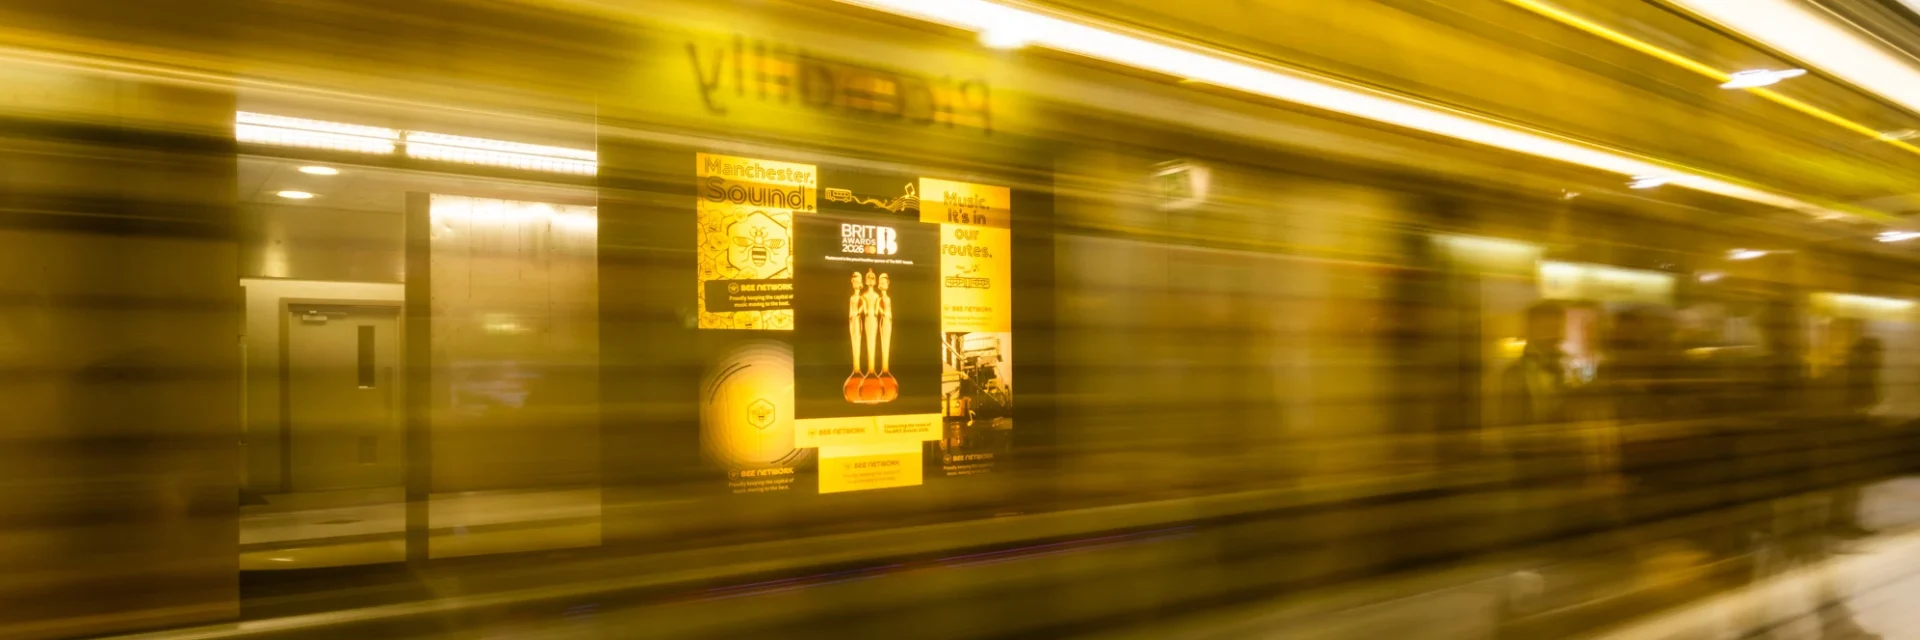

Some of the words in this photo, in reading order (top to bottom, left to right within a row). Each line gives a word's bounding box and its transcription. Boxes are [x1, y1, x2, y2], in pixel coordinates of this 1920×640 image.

[704, 157, 814, 185] Manchester.
[707, 175, 813, 211] Sound.
[943, 190, 990, 210] Music.
[947, 208, 970, 224] It's
[973, 210, 987, 225] in
[841, 223, 876, 239] BRIT
[954, 228, 979, 241] our
[842, 245, 864, 254] 2026
[942, 244, 993, 259] routes.
[741, 284, 756, 292] BEE
[756, 283, 793, 291] NETWORK
[868, 459, 900, 467] NETWORK
[741, 470, 756, 478] BEE
[756, 467, 794, 476] NETWORK
